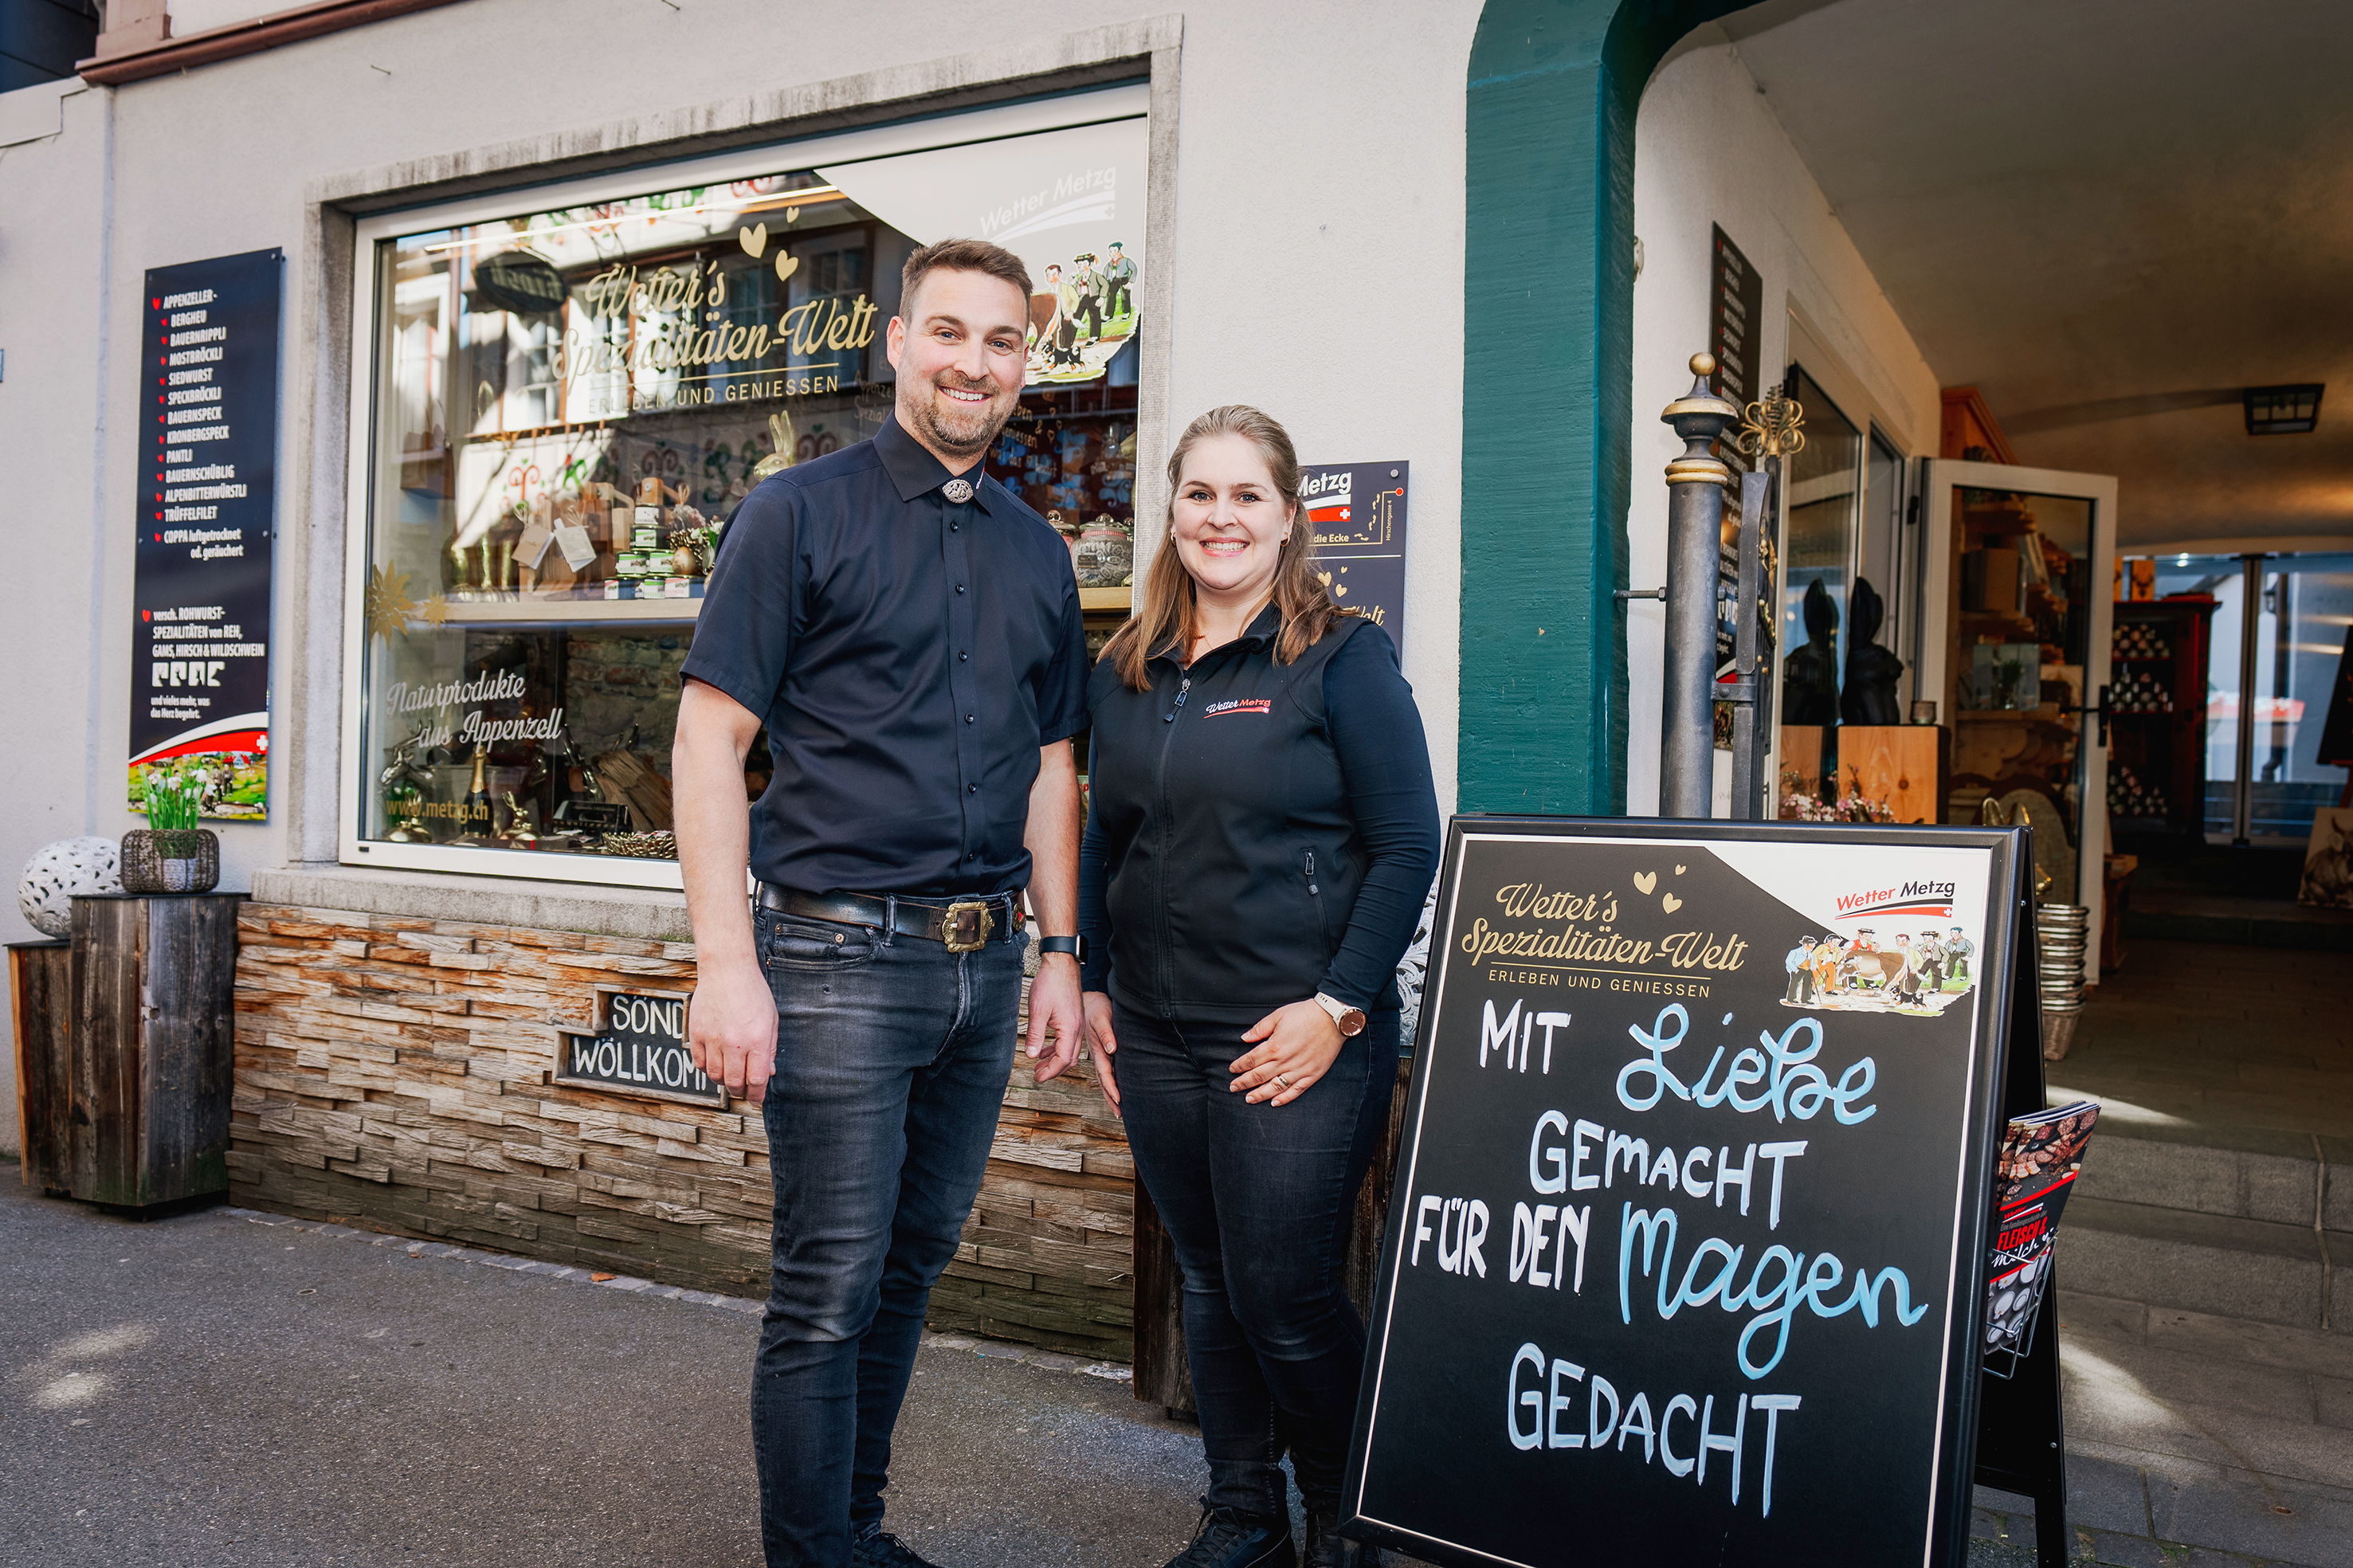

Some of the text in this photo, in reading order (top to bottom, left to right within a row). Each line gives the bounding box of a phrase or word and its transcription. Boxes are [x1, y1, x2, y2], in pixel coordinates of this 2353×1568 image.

[980, 166, 1116, 236] Wetter Metzg
[163, 288, 218, 309] APPENZELLER-
[585, 260, 726, 319] Wetter's
[171, 309, 207, 327] BERGHEU
[170, 326, 226, 347] BAUERNRIPPLI
[551, 293, 878, 397] Spezialitäten-Welt
[169, 347, 223, 367] MOSTBRÖCKLI
[168, 367, 214, 386] SIEDWURST
[167, 386, 222, 406] SPECKBRÖCKLI
[589, 374, 838, 414] ERLEBEN UND GENIESSEN
[167, 406, 222, 425] BAUERNSPECK
[167, 425, 229, 445] KRONBERGSPECK
[166, 449, 193, 464] PANTLI
[166, 464, 235, 484] BAUERNSCHÜBLIG
[1296, 472, 1352, 497] Metzg
[165, 483, 247, 503] ALPENBITTERWÜRSTLI
[164, 506, 218, 522] TRÜFFELFILET
[164, 527, 241, 544] COPPA luftgetrocknet
[1314, 533, 1350, 543] die Ecke
[190, 544, 244, 561] od. geräuchert
[153, 606, 225, 621] versch. ROHWURST-
[153, 623, 243, 640] SPEZIALITÄTEN von REH,
[152, 643, 265, 658] GAMS, HIRSCH & WILDSCHWEIN
[151, 695, 210, 708] und vieles mehr, was
[386, 668, 526, 717] Naturprodukte
[150, 708, 202, 721] das Herz begehrt.
[1206, 700, 1239, 714] Wetter
[418, 708, 563, 753] aus Appenzell
[386, 799, 489, 825] www.metzg.ch
[1496, 882, 1618, 922] Wetter's
[1835, 880, 1956, 912] Wetter Metzg
[1461, 917, 1748, 972] Spezialitäten-Welt
[1488, 969, 1710, 999] ERLEBEN UND GENIESSEN
[612, 994, 683, 1040] SÖND
[574, 1036, 720, 1094] WÖLLKOM
[1479, 998, 1878, 1127] MIT Liebe
[1528, 1110, 1808, 1231] GEMACHT
[2004, 1205, 2027, 1220] Wetter
[1997, 1216, 2048, 1251] FLEISCH &
[1410, 1194, 1929, 1380] FÜR DEN Magen
[1507, 1342, 1802, 1519] GEDACHT
